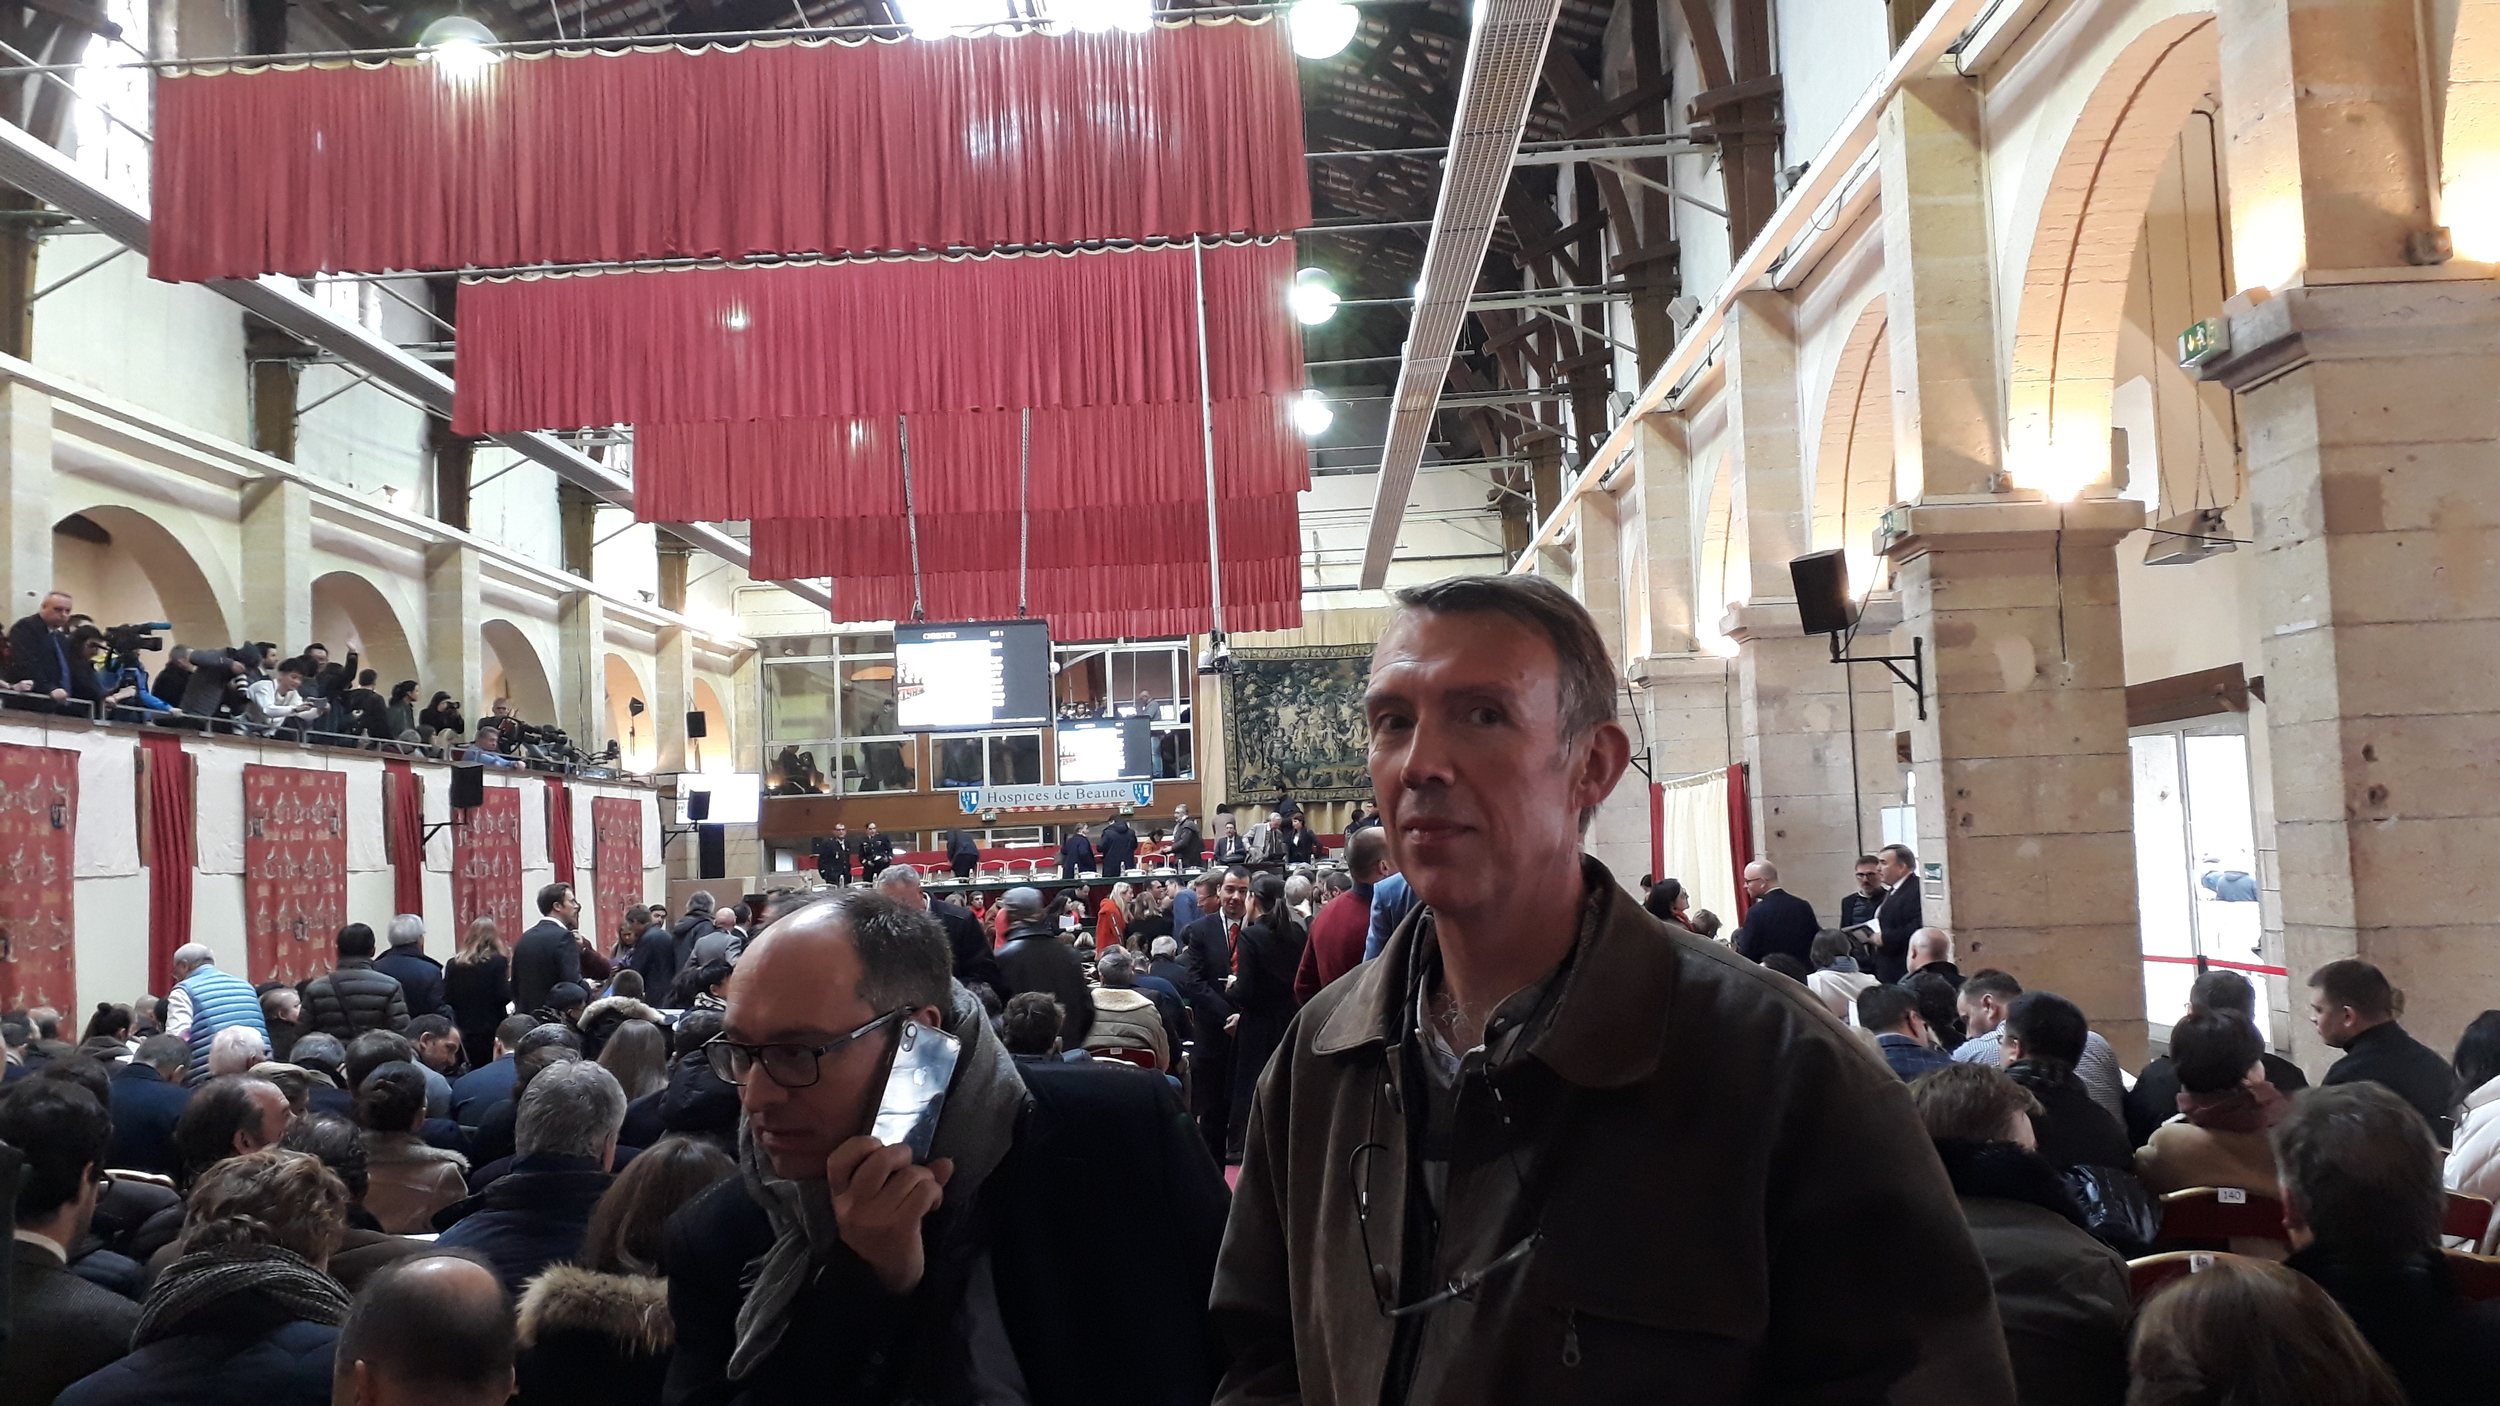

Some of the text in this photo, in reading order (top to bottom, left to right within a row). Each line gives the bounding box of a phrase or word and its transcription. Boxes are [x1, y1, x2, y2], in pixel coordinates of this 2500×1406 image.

[987, 788, 1126, 804] Hospices de Beaune
[2224, 1190, 2241, 1200] 140
